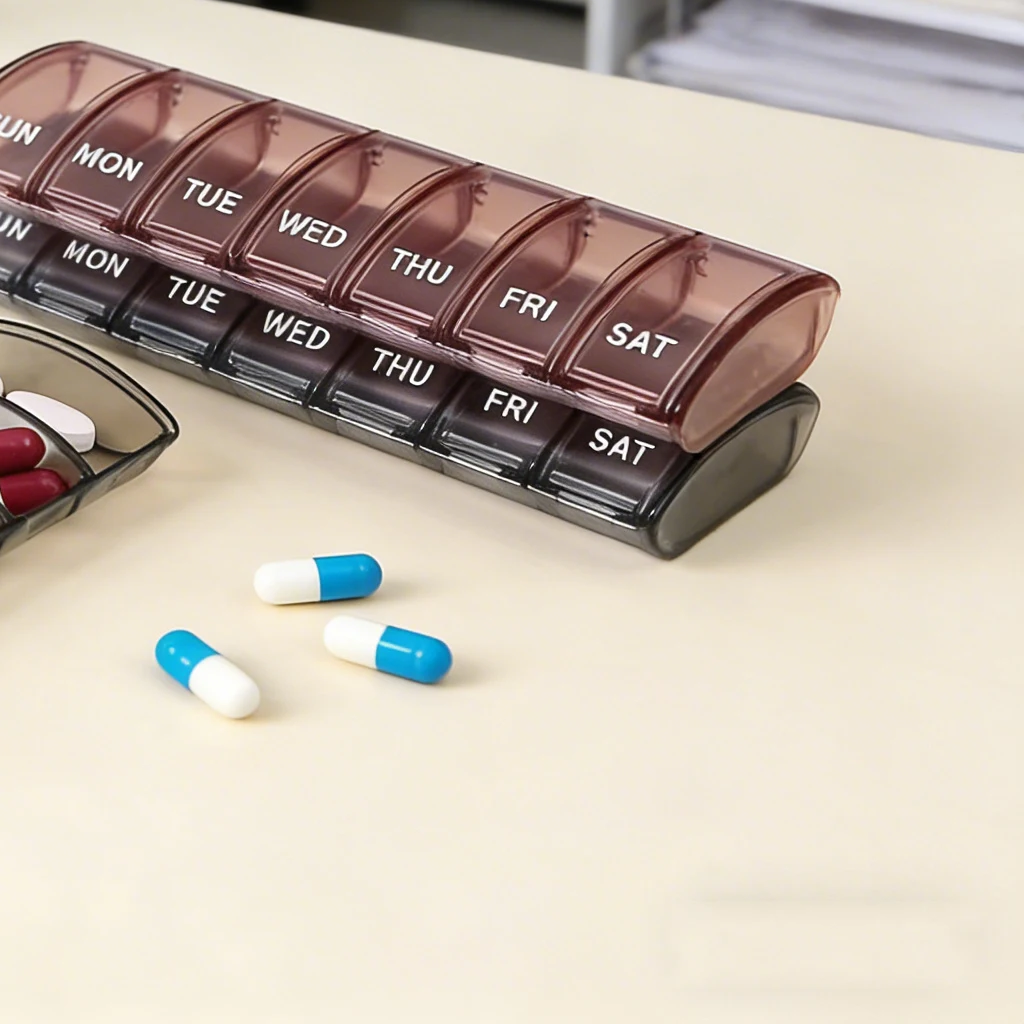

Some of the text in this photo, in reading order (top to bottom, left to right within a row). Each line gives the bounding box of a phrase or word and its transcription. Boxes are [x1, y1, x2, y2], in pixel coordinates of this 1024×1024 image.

[62, 239, 130, 278] MON
[168, 275, 226, 314] TUE
[263, 309, 331, 350] WED
[372, 347, 435, 386] THU
[483, 388, 539, 424] FRI
[588, 428, 656, 466] SAT
[71, 142, 144, 182] MON
[183, 177, 243, 215] TUE
[278, 209, 348, 248] WED
[390, 247, 454, 284] THU
[499, 287, 558, 322] FRI
[606, 322, 679, 358] SAT
